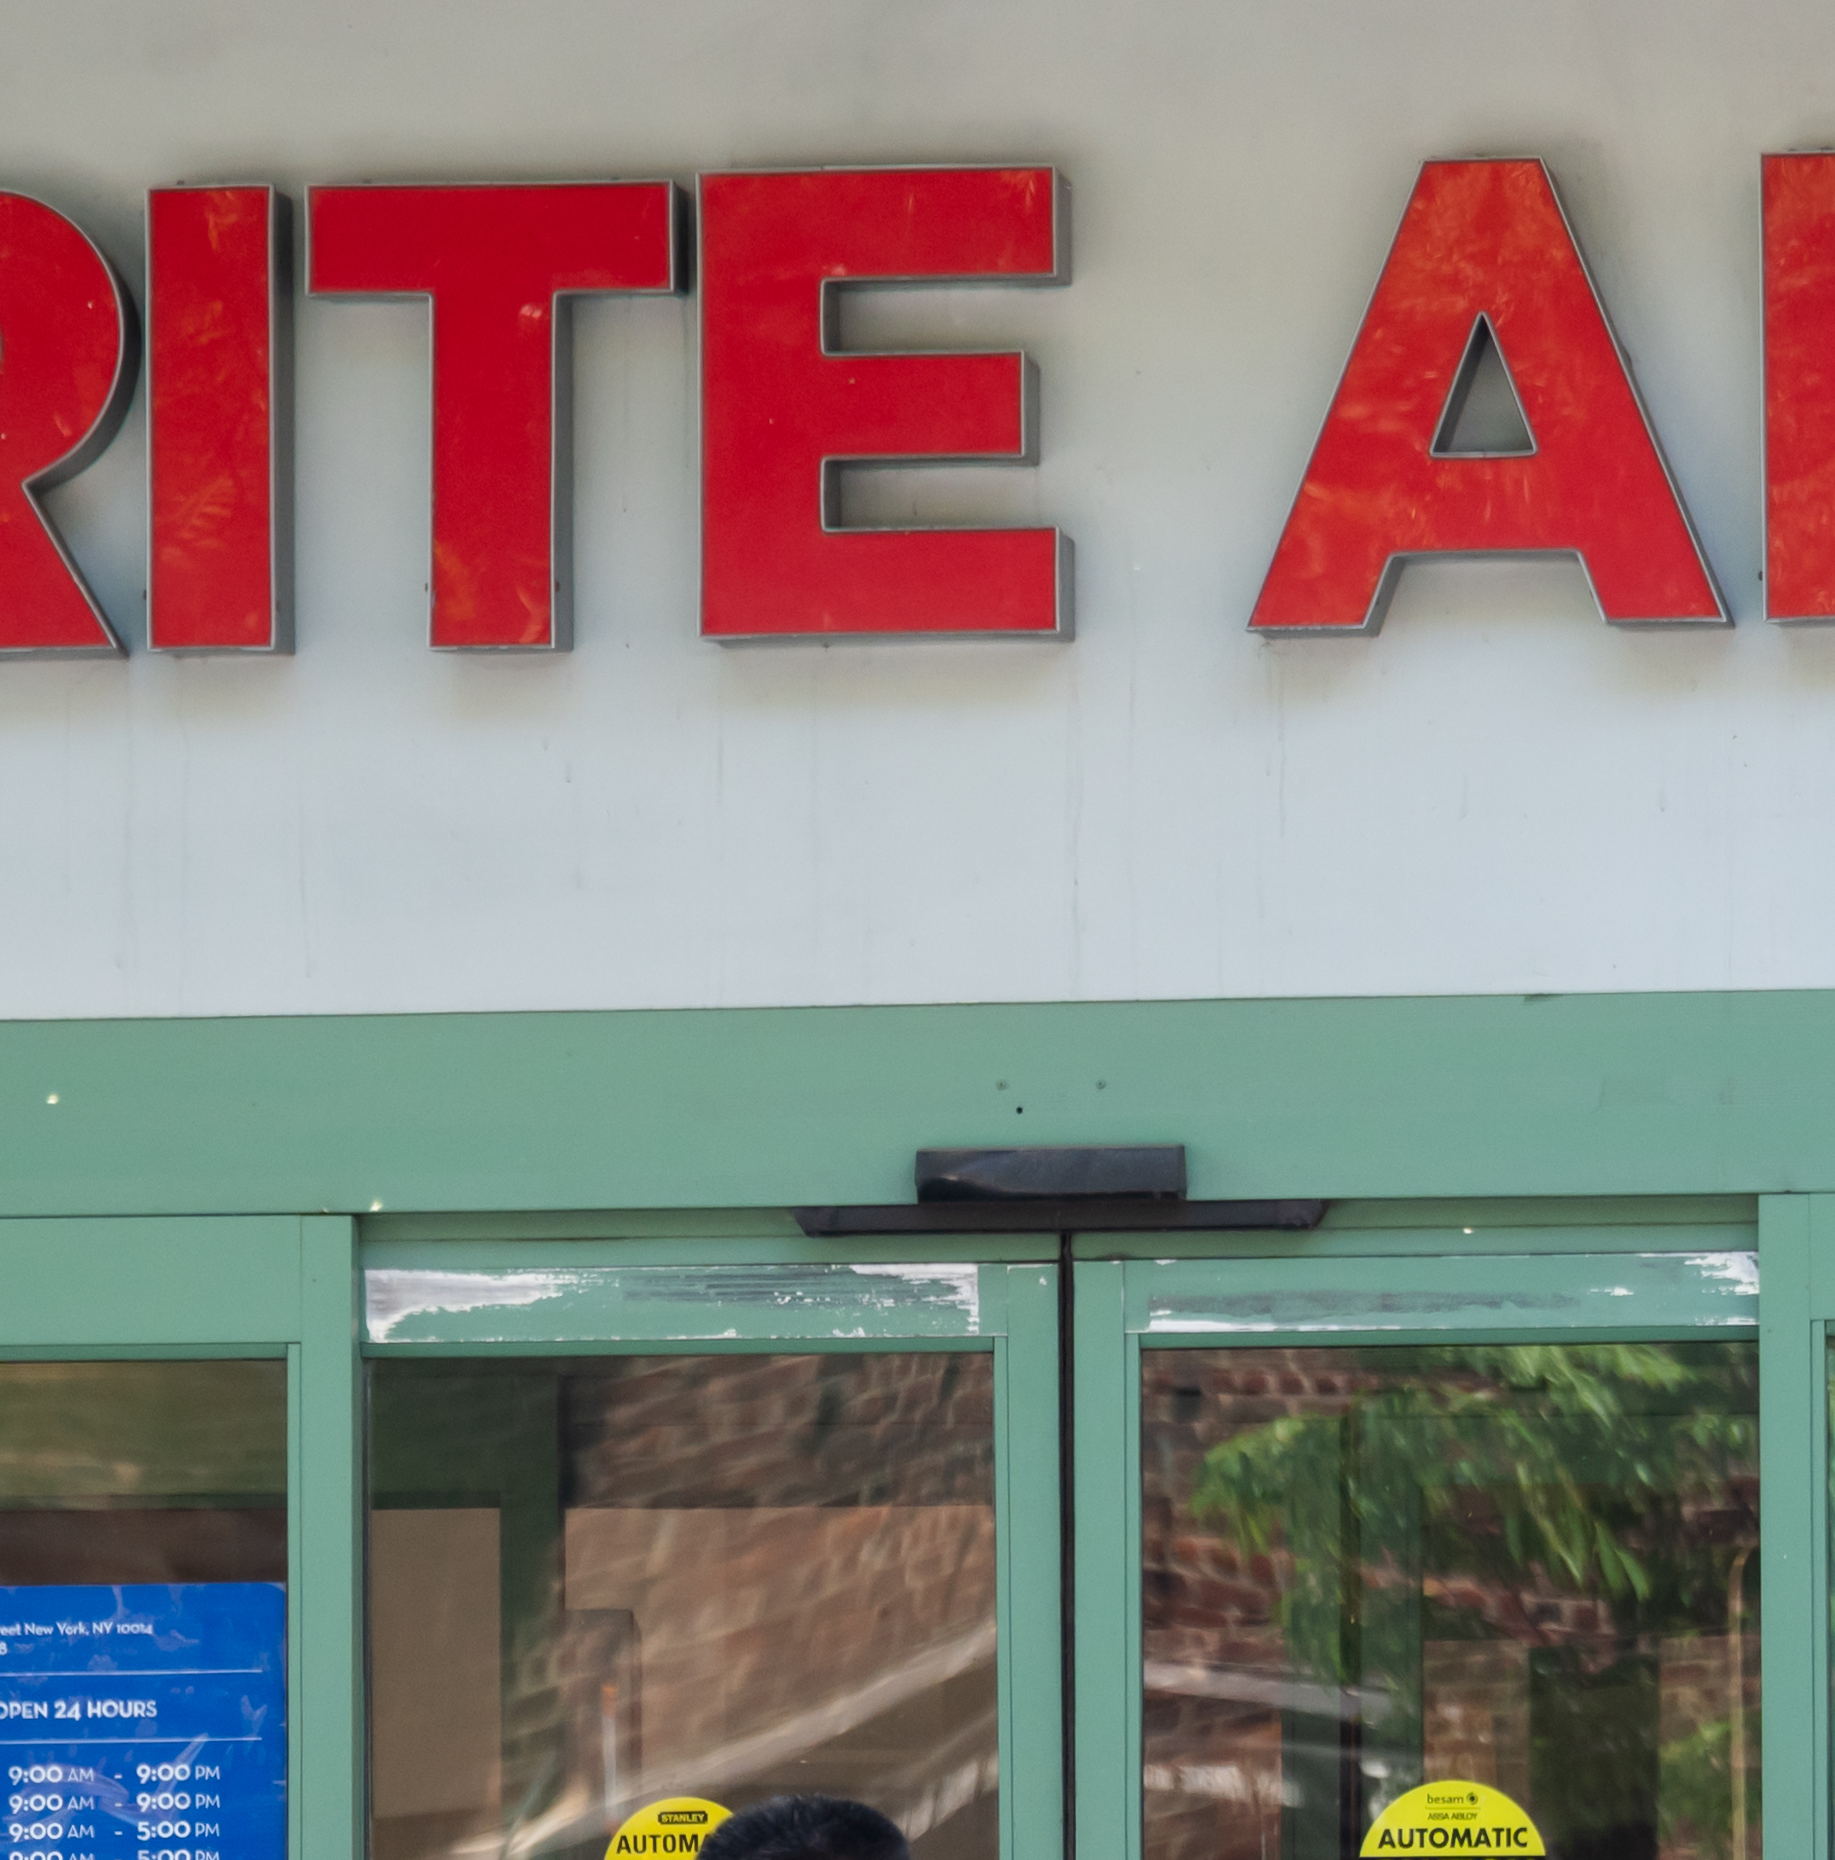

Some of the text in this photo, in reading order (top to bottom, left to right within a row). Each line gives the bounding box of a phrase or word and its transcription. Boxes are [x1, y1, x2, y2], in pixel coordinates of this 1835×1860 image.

[24, 1622, 54, 1636] New
[57, 1621, 90, 1636] York,
[92, 1621, 113, 1635] NY
[53, 1700, 82, 1722] 24
[86, 1700, 158, 1719] HOURS
[8, 1764, 64, 1786] 9:00
[67, 1766, 96, 1783] AM
[135, 1762, 191, 1784] 9:00
[194, 1766, 222, 1781] PM
[8, 1793, 64, 1814] 9:00
[67, 1795, 96, 1811] AM
[135, 1791, 191, 1813] 9:00
[194, 1794, 222, 1809] PM
[1427, 1793, 1465, 1805] besam
[661, 1813, 705, 1823] STANLEY
[1427, 1812, 1450, 1821] ASSA
[8, 1822, 64, 1842] 9:00
[67, 1824, 96, 1840] AM
[135, 1820, 191, 1842] 5:00
[194, 1822, 222, 1838] PM
[1377, 1827, 1528, 1849] AUTOMATIC
[616, 1834, 699, 1854] AUTOM
